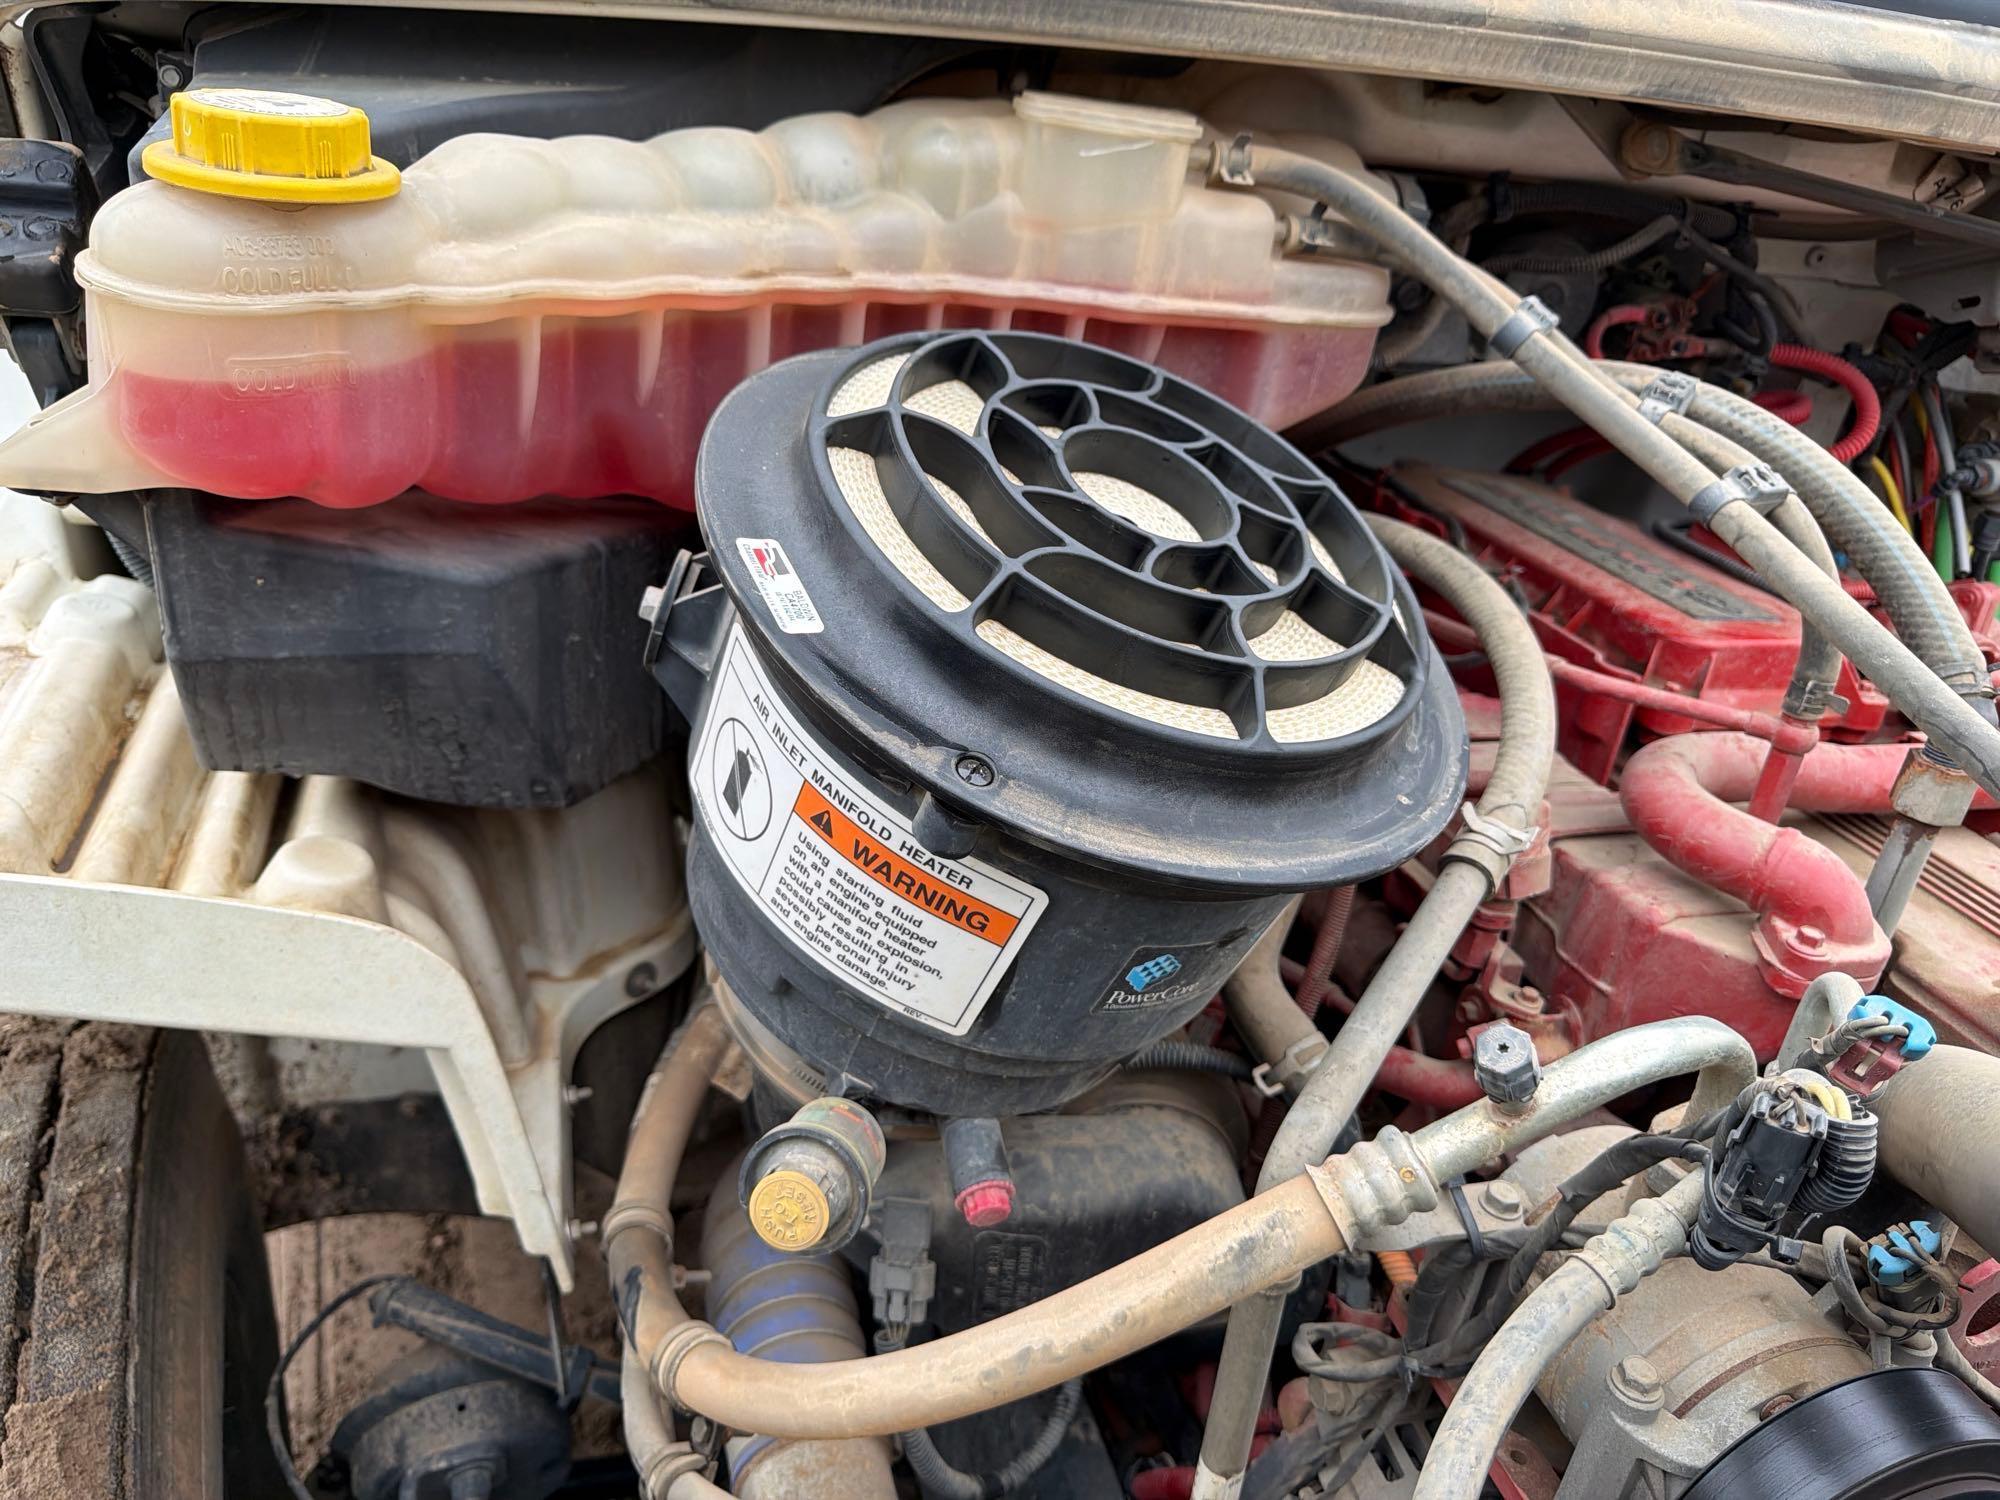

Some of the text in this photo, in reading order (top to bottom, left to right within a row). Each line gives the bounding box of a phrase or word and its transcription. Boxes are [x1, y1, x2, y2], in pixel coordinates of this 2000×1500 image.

[223, 263, 338, 294] COLD FULL
[233, 367, 297, 392] COLD
[785, 593, 805, 620] CA4700
[792, 590, 816, 622] BALDWIN
[753, 694, 974, 890] AIR INLET MANIFOLD HEATER
[778, 876, 909, 975] possibly resulting in
[784, 866, 943, 980] could cause an explosion,
[789, 854, 927, 956] with a manifold heater
[793, 845, 938, 949] on an engine equipped
[798, 831, 923, 928] Using starting fluid
[853, 838, 990, 933] WARNING
[770, 896, 889, 990] and engine damage.
[775, 886, 916, 991] severe personal injury
[1106, 981, 1199, 1004] PowerCore
[761, 1208, 799, 1240] PUSH
[775, 1202, 799, 1225] TO
[776, 1182, 816, 1223] RESET
